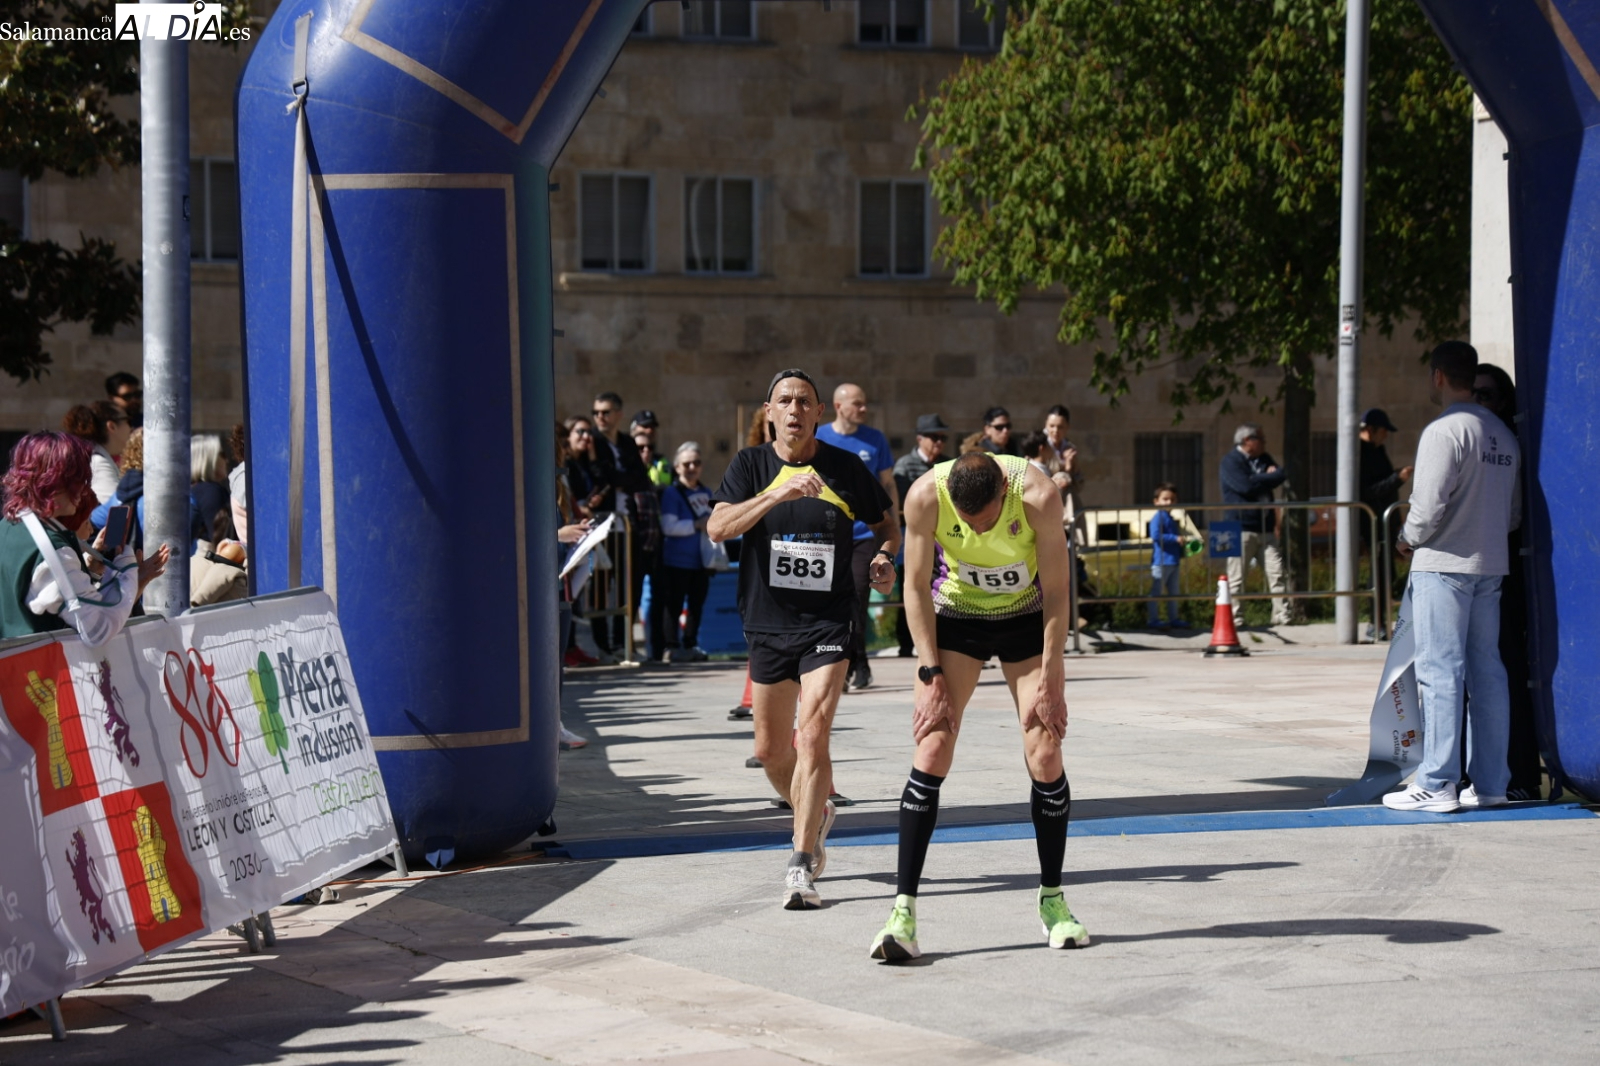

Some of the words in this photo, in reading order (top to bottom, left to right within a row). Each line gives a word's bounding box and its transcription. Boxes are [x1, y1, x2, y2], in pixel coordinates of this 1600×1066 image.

[776, 556, 827, 579] 583
[967, 570, 1020, 587] 159
[277, 646, 349, 718] Plena
[186, 817, 220, 851] LEÓN
[218, 816, 228, 840] Y
